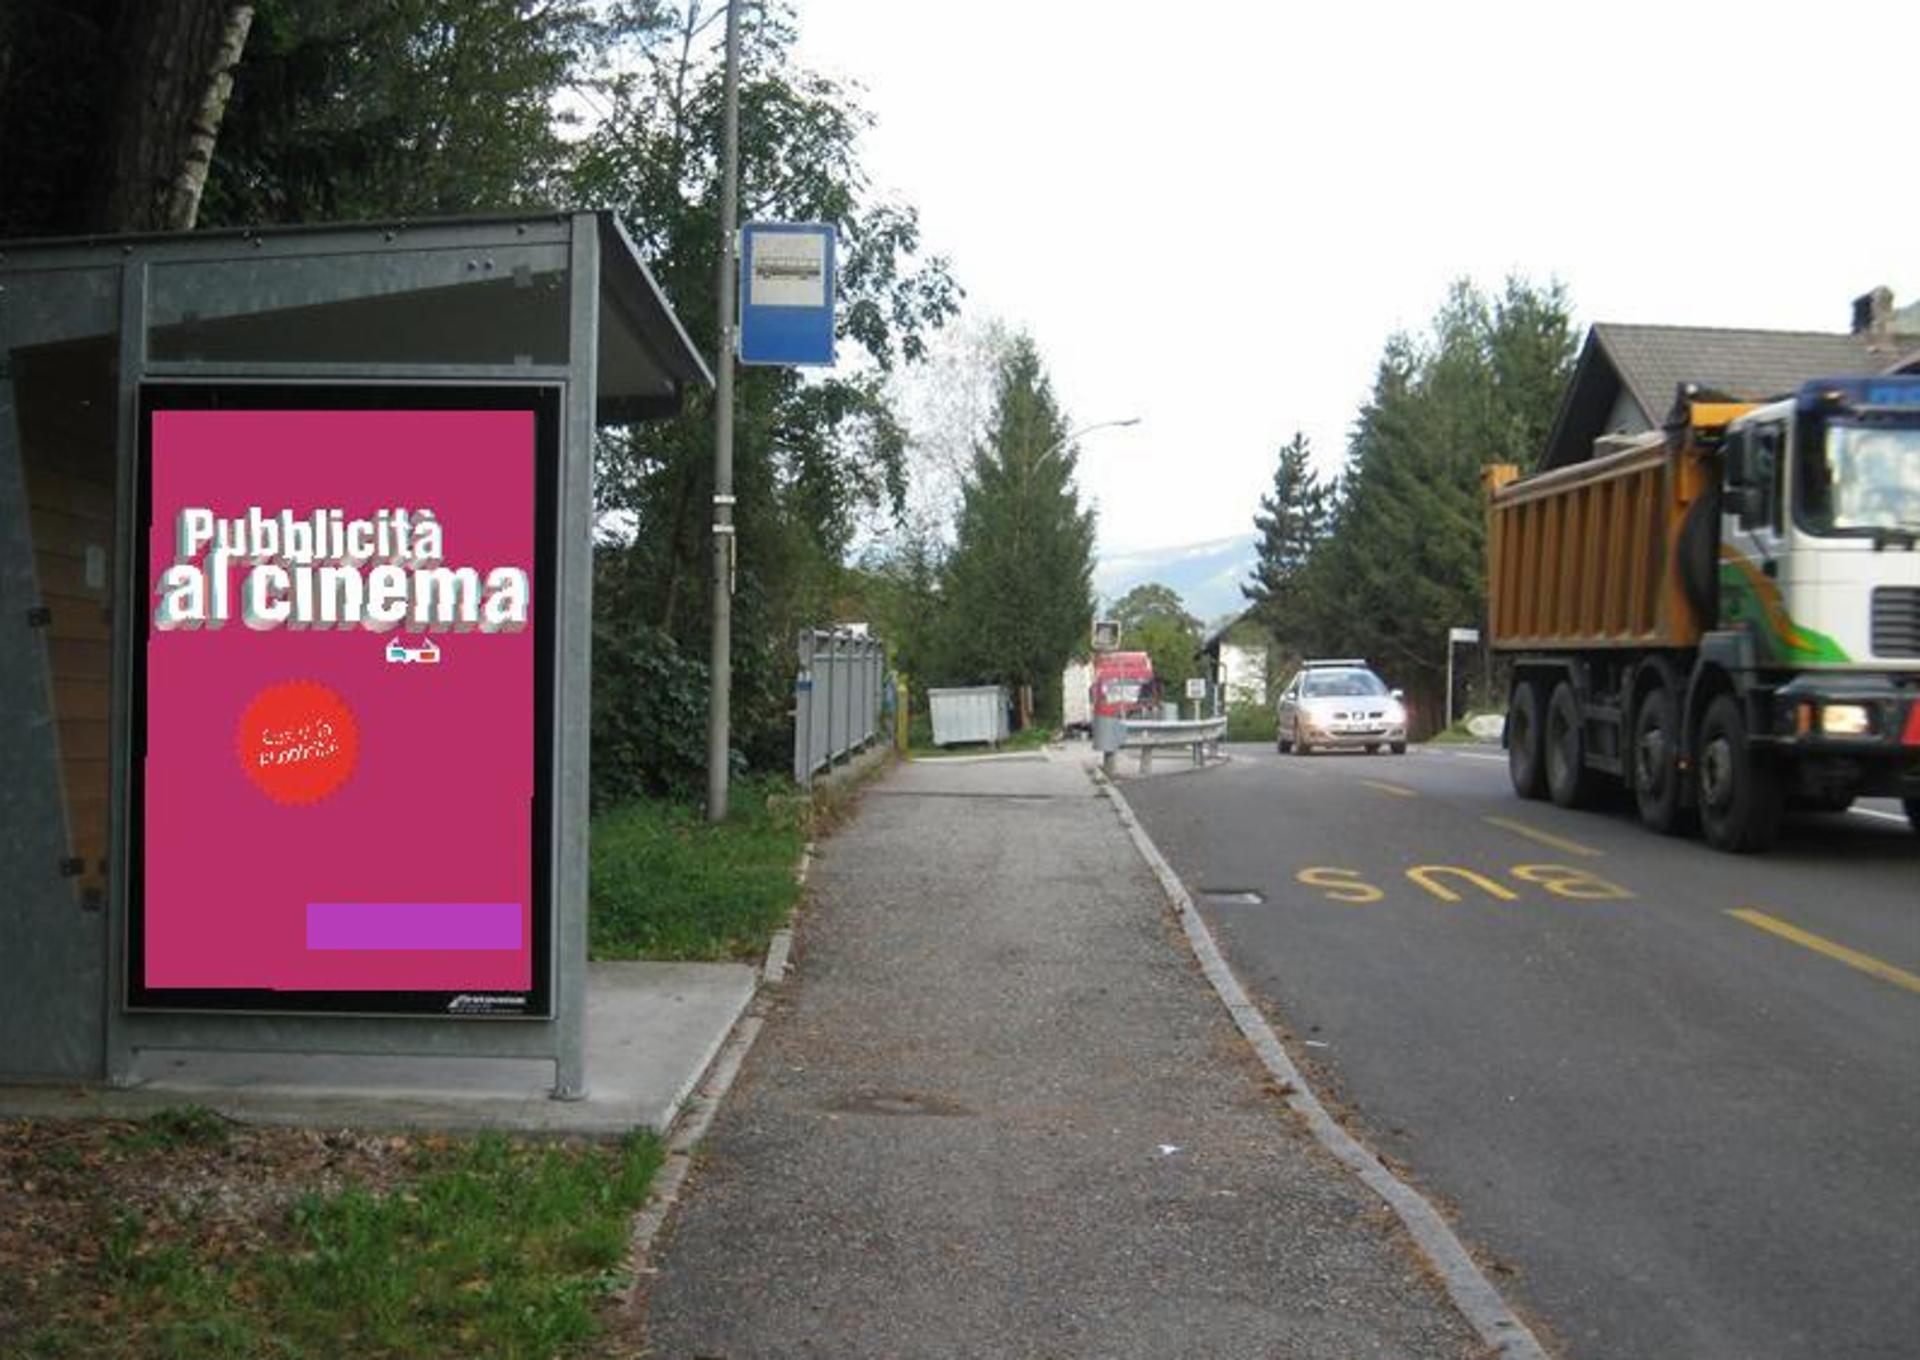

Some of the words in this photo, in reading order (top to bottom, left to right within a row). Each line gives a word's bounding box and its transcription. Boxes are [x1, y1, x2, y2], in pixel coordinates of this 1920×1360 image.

[178, 507, 443, 564] Pubblicità
[156, 546, 229, 629] al
[244, 563, 529, 631] cinema
[1296, 865, 1635, 902] BUS
